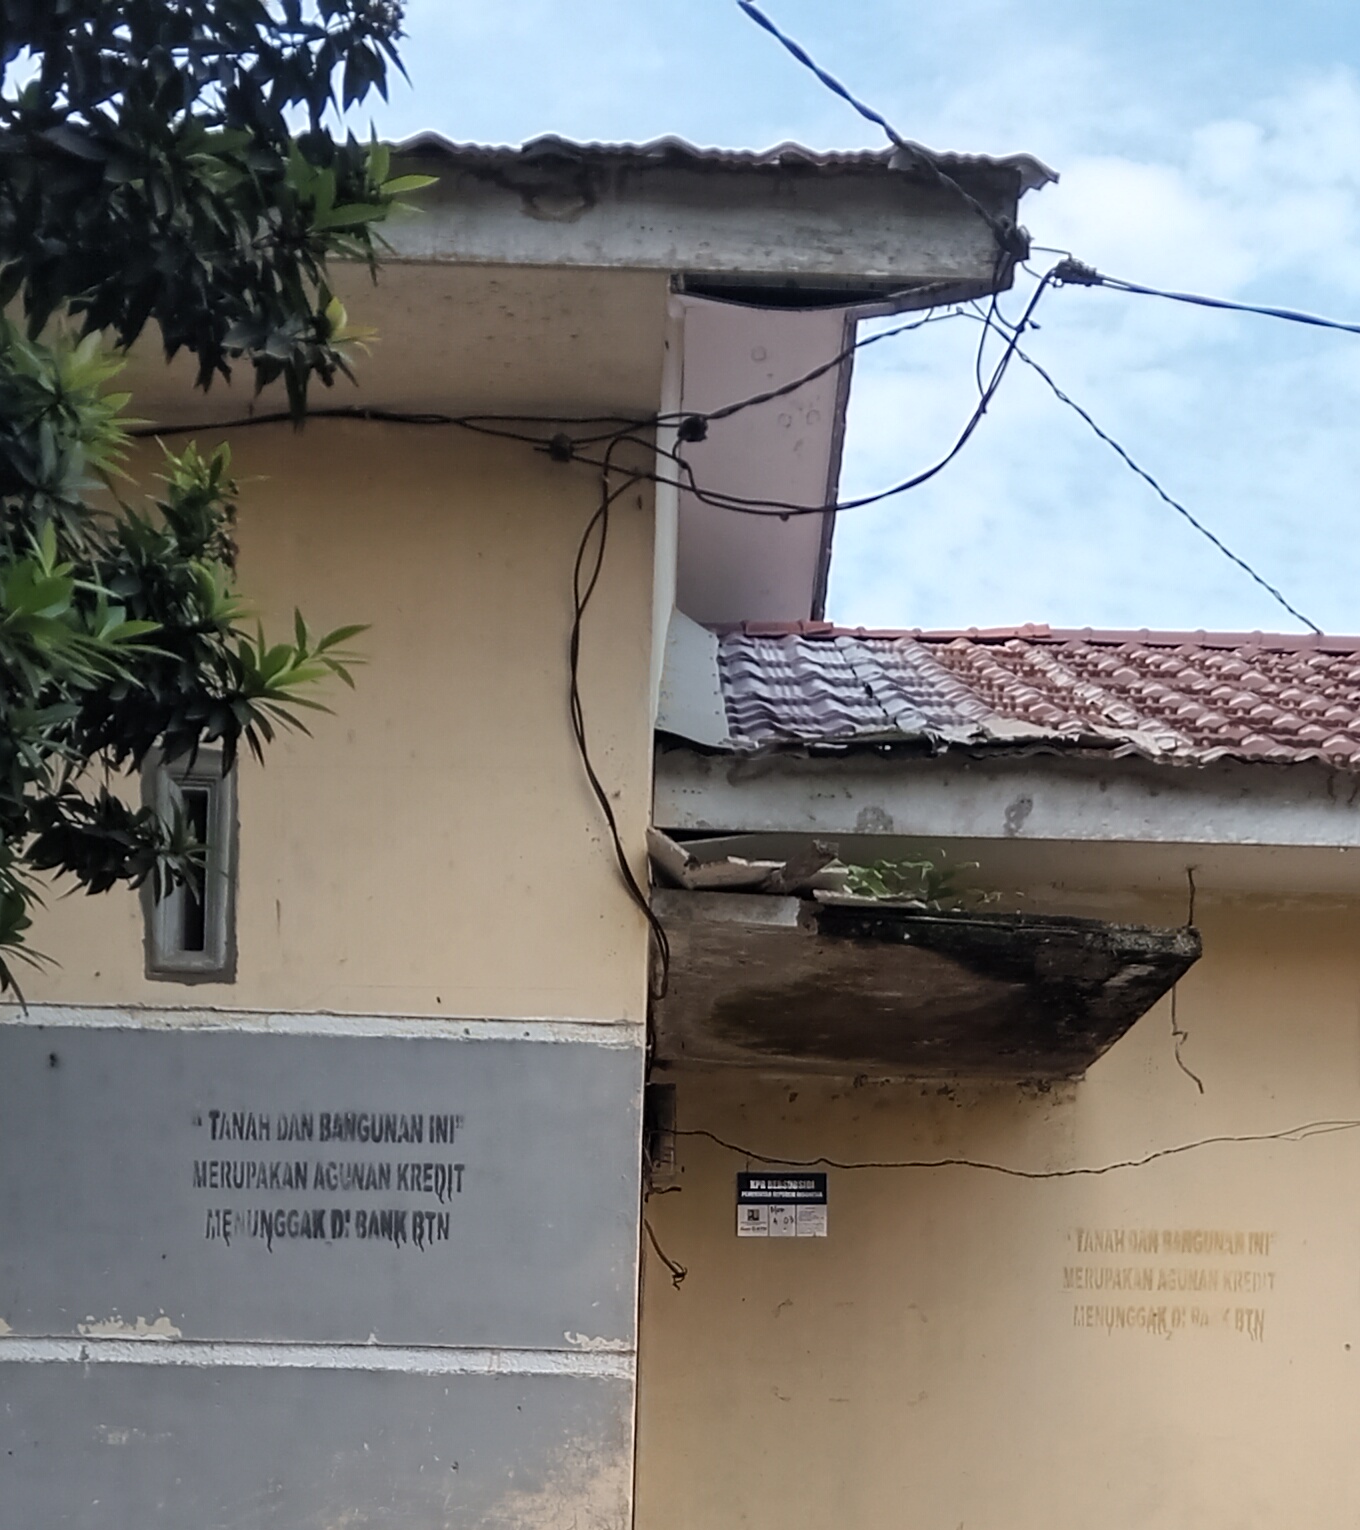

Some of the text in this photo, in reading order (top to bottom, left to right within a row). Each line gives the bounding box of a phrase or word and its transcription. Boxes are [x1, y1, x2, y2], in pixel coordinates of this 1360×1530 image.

[208, 1110, 271, 1142] TANAH
[276, 1112, 314, 1143] DAN
[319, 1112, 424, 1144] BANGUNAN
[192, 1160, 466, 1198] MERUPAKAN AGUNAN KREDIT
[354, 1210, 408, 1243] BANK
[412, 1212, 451, 1245] BTN
[1076, 1228, 1126, 1254] TANAH
[1062, 1266, 1154, 1292] MERUPAKAN
[1157, 1267, 1219, 1293] AGUNAN
[1073, 1304, 1169, 1335] MENUNGGAK
[1235, 1307, 1265, 1341] BTN
